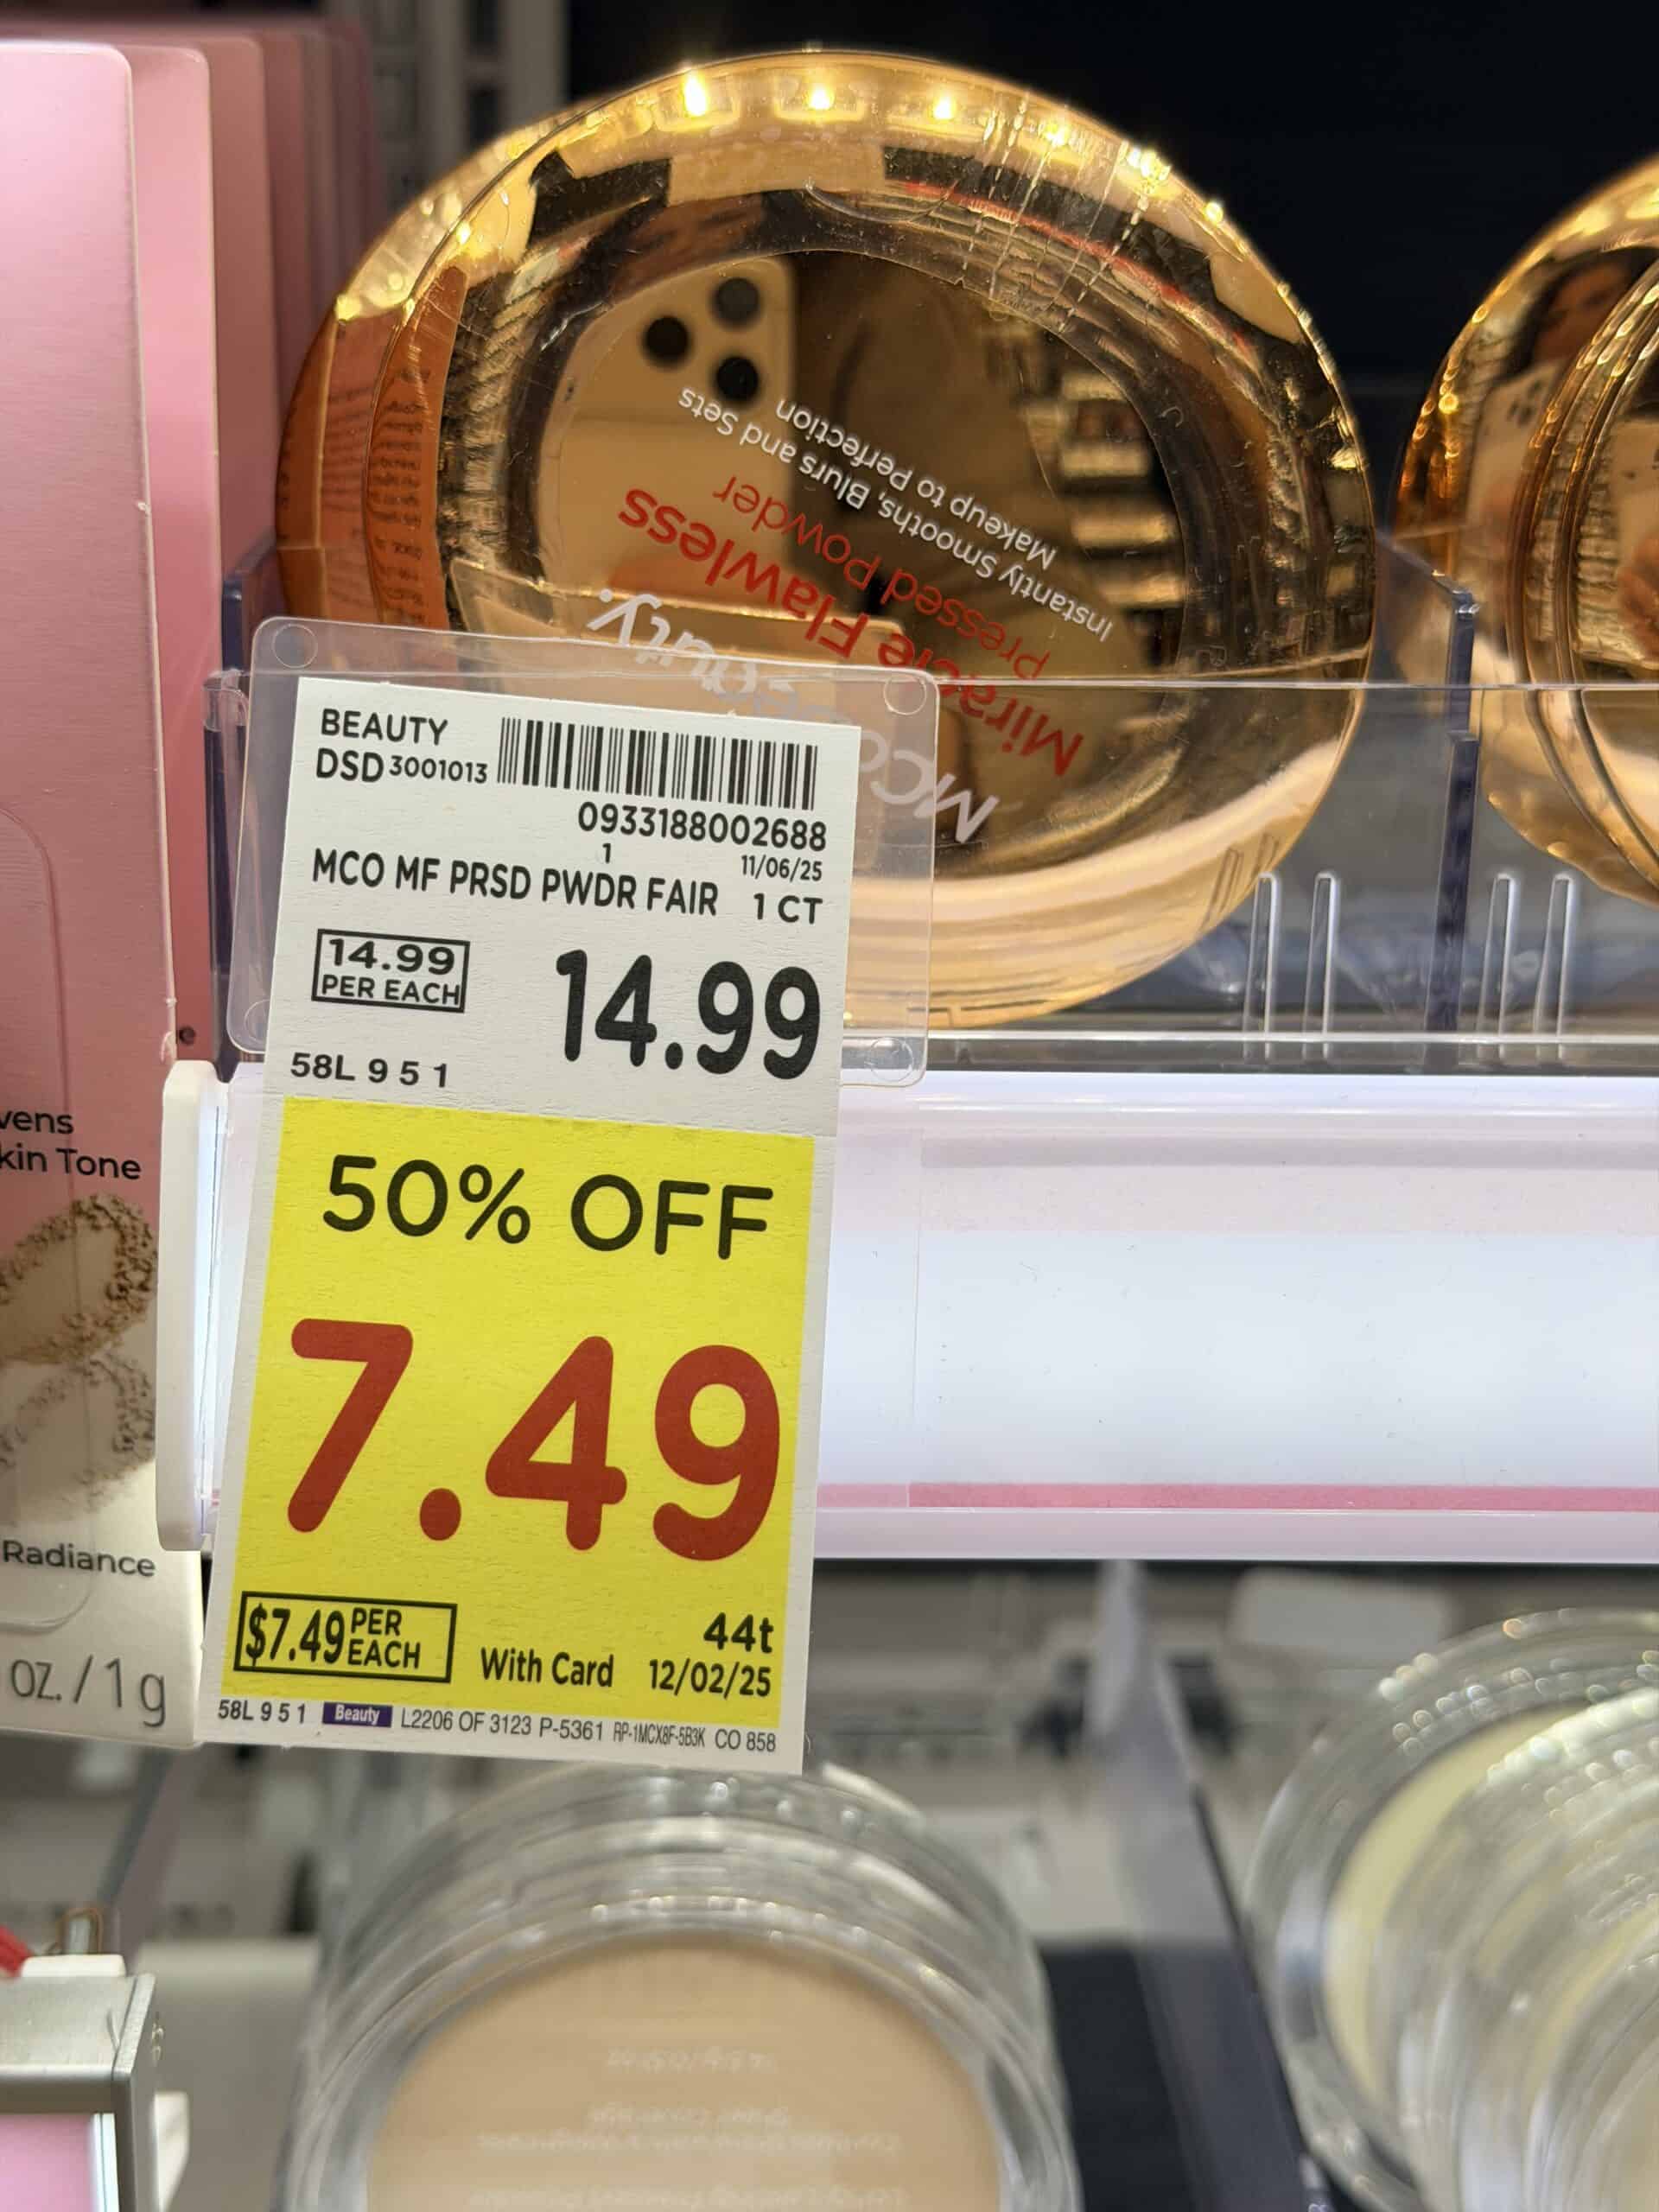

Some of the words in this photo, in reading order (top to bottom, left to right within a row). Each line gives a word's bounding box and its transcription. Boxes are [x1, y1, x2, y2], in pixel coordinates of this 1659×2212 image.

[678, 387, 739, 435] Sets
[740, 423, 797, 463] and
[775, 399, 913, 492] Perfection
[798, 454, 871, 510] Blurs
[917, 479, 945, 508] to
[712, 476, 880, 590] Powder
[878, 491, 998, 579] Smooths,
[950, 495, 1057, 570] Makeup
[618, 487, 869, 659] Flawless
[880, 567, 1052, 680] Pressed
[999, 564, 1114, 643] Instantly
[321, 708, 448, 747] BEAUTY
[315, 747, 385, 783] DSD
[389, 755, 488, 785] 3001013
[577, 801, 827, 852] 0933188002688
[601, 842, 612, 864] 1
[741, 854, 823, 883] 11/06/25
[312, 848, 385, 888] MCO
[395, 854, 441, 892] MF
[449, 859, 531, 899] PRSD
[541, 867, 637, 910] PWDR
[646, 876, 719, 916] FAIR
[753, 892, 765, 920] 1
[777, 894, 823, 925] CT
[328, 937, 456, 976] 14.99
[321, 974, 375, 998] PER
[384, 980, 461, 1007] EACH
[556, 948, 822, 1080] 14.99
[290, 1052, 356, 1082] 58L
[367, 1058, 389, 1084] 9
[399, 1061, 420, 1086] 5
[433, 1063, 448, 1089] 1
[55, 1147, 142, 1180] Tone
[322, 1154, 531, 1244] 50%
[569, 1173, 774, 1261] OFF
[287, 1318, 781, 1561] 7.49
[3, 1539, 156, 1578] Radiance
[245, 1602, 346, 1667] $7.49
[350, 1606, 403, 1637] PER
[703, 1611, 774, 1655] 44t
[347, 1638, 421, 1669] EACH
[480, 1646, 543, 1683] With
[551, 1651, 614, 1688] Card
[649, 1656, 772, 1700] 12/02/25
[218, 1698, 254, 1721] 58L
[260, 1701, 272, 1721] 9
[278, 1702, 290, 1723] 5
[297, 1703, 306, 1724] 1
[334, 1703, 380, 1726] Beauty
[401, 1707, 454, 1732] L2206
[459, 1710, 485, 1732] OF
[490, 1713, 532, 1736] 3123
[539, 1717, 604, 1741] P-5361
[715, 1728, 741, 1751] CO
[747, 1731, 777, 1753] 858
